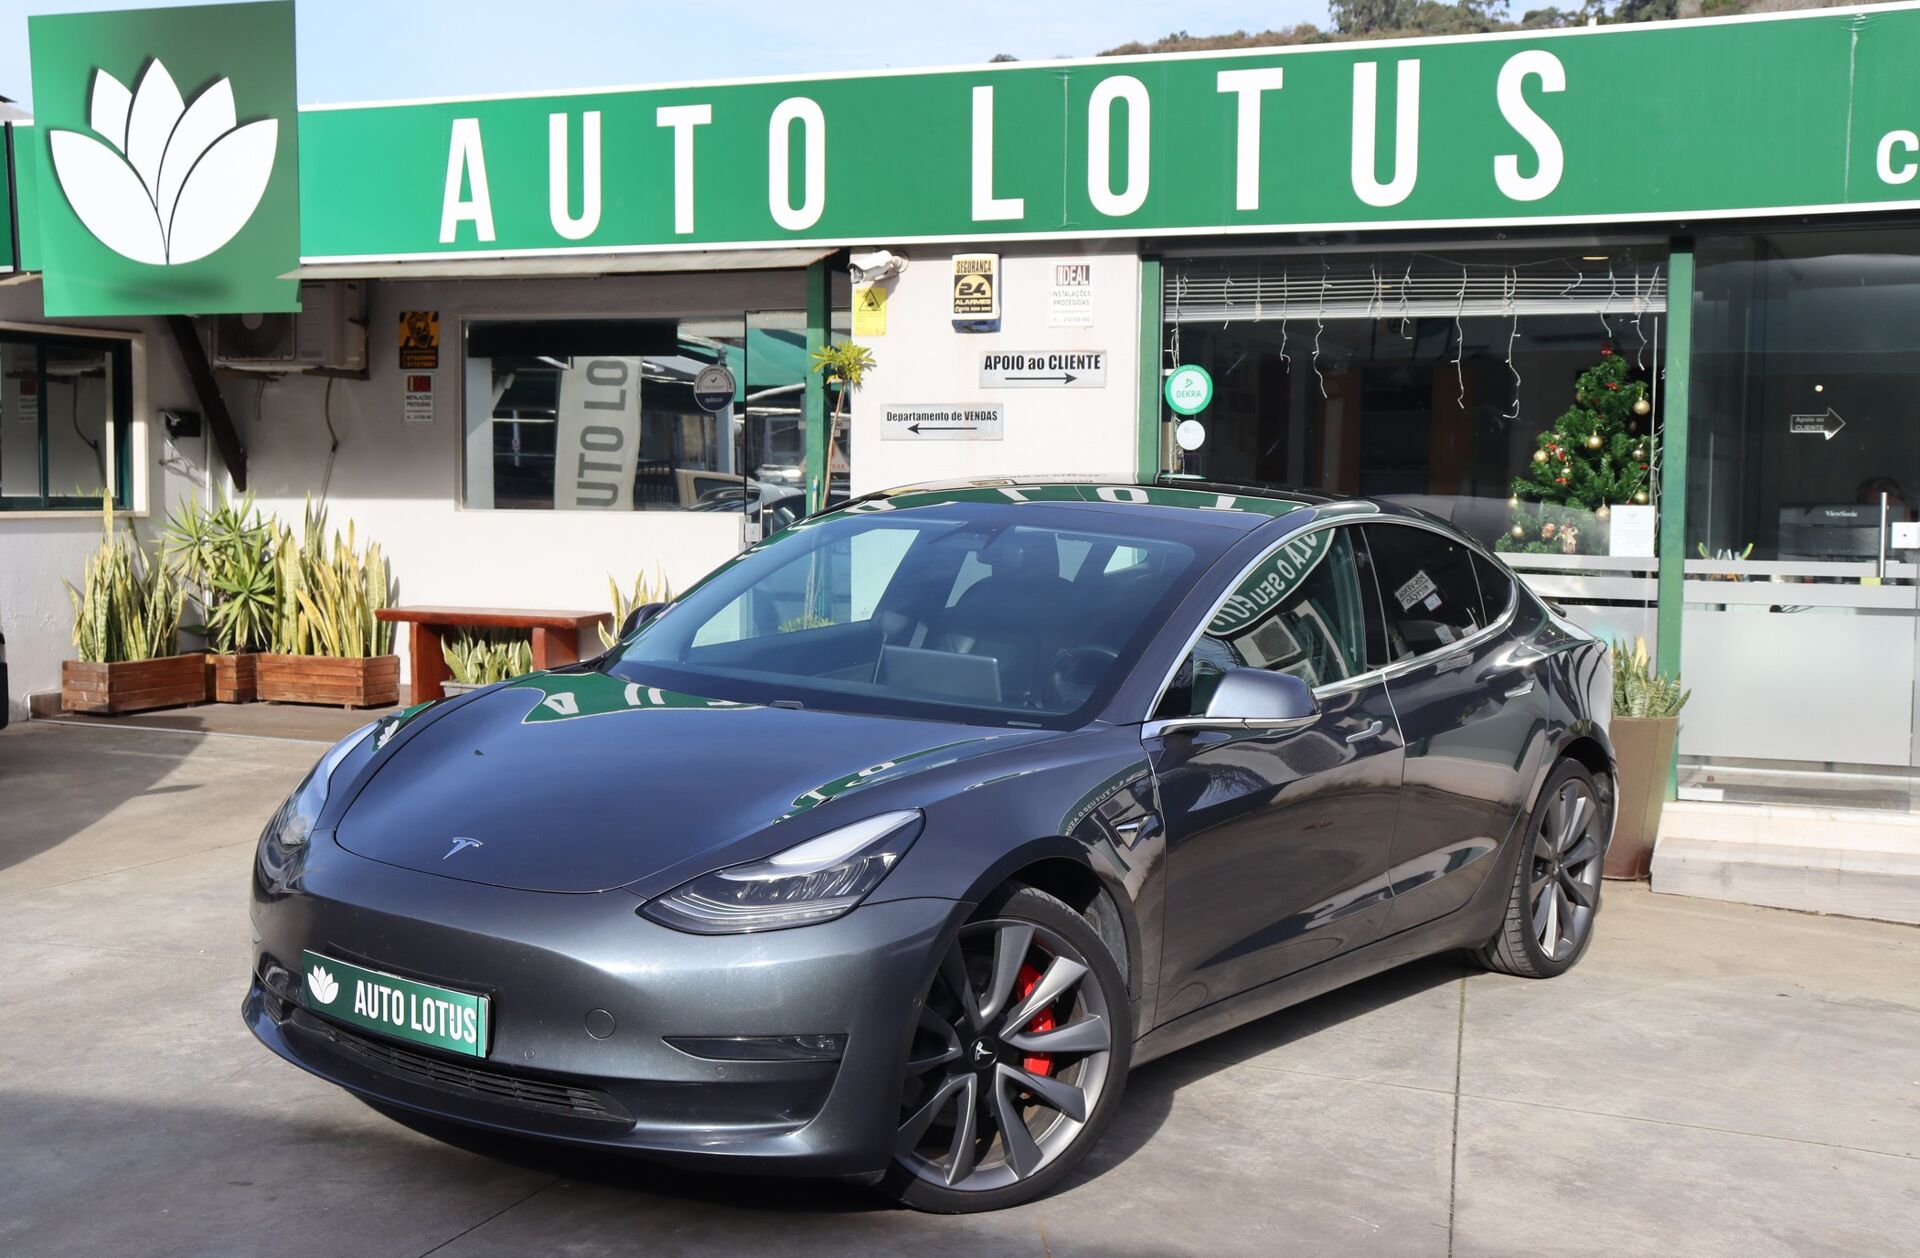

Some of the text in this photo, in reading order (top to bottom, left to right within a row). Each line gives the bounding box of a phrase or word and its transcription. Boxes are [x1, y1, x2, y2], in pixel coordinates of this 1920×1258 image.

[439, 49, 1566, 243] AUTO LOTUS
[958, 282, 986, 296] 24
[984, 354, 1101, 370] APOIO ao CLIENTE
[1176, 390, 1202, 398] DEKRA
[886, 411, 998, 422] Departamento de VENDAS
[354, 980, 477, 1044] AUTO LOTUS
